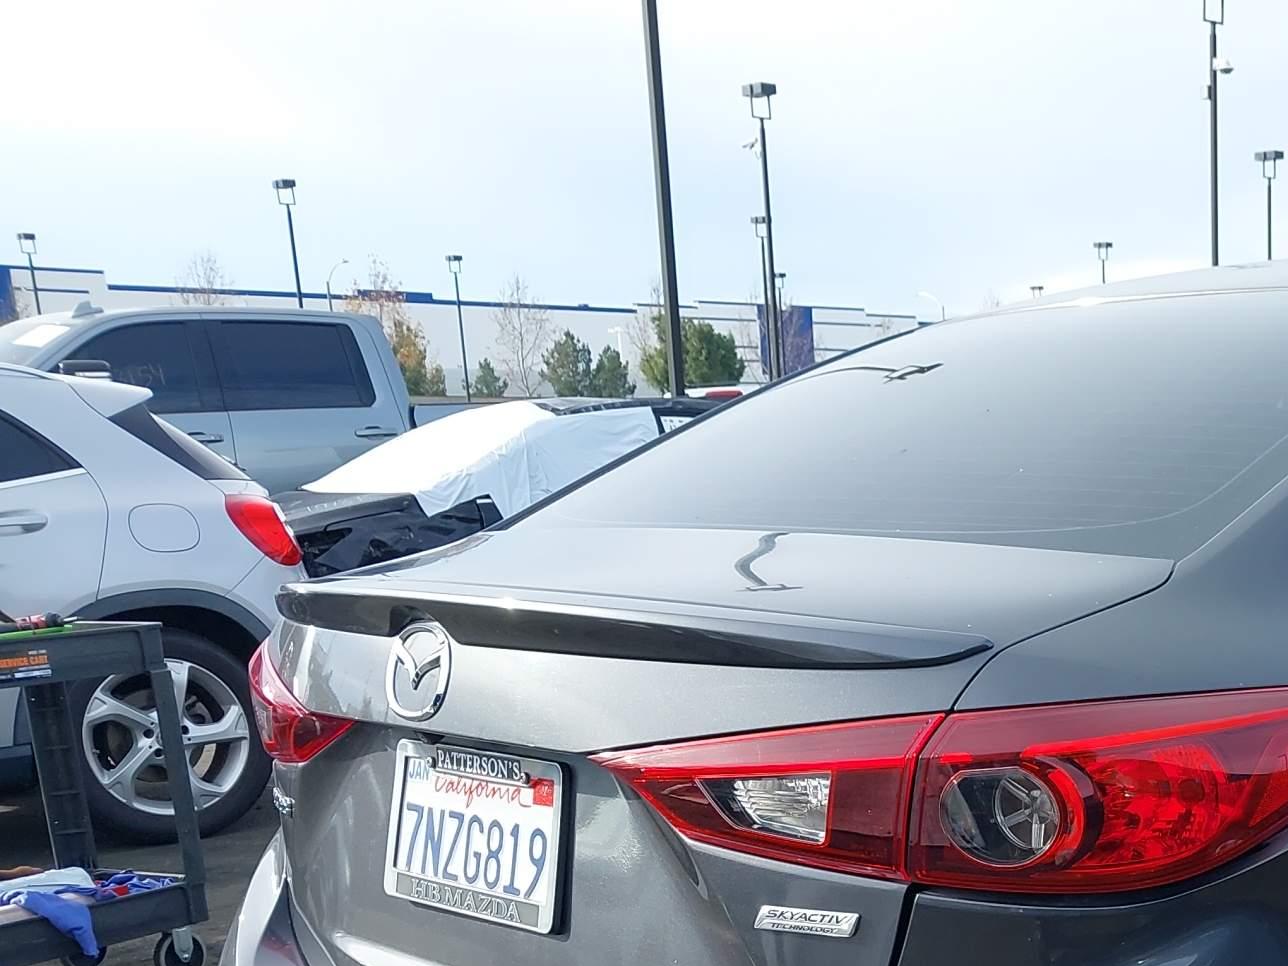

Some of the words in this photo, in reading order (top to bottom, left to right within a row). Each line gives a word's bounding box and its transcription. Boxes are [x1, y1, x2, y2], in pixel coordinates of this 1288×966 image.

[437, 750, 521, 781] PATTERSON'S
[435, 775, 532, 808] California
[406, 803, 548, 899] 7NZG819
[410, 878, 441, 899] HB
[443, 886, 521, 923] MAZDA
[766, 909, 847, 924] SKYACTIV
[771, 922, 838, 934] TECHNOLOGY
